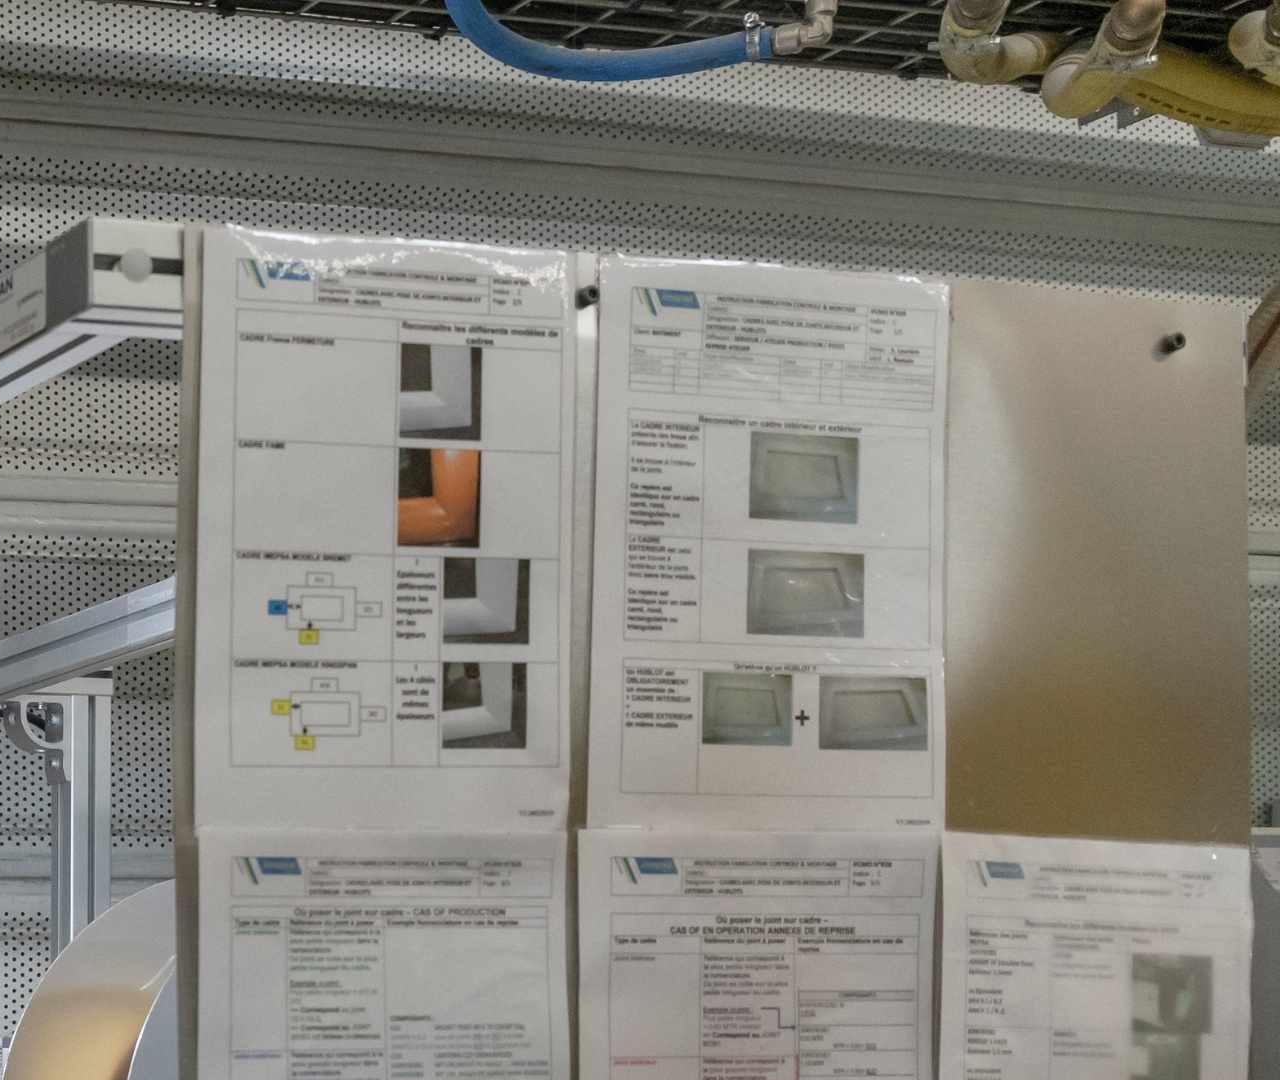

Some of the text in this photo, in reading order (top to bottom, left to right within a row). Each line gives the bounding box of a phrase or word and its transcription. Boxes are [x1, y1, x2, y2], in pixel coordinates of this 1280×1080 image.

[448, 907, 507, 918] PRODUCTION
[716, 925, 764, 936] OPERATION
[818, 925, 856, 936] REPRISE
